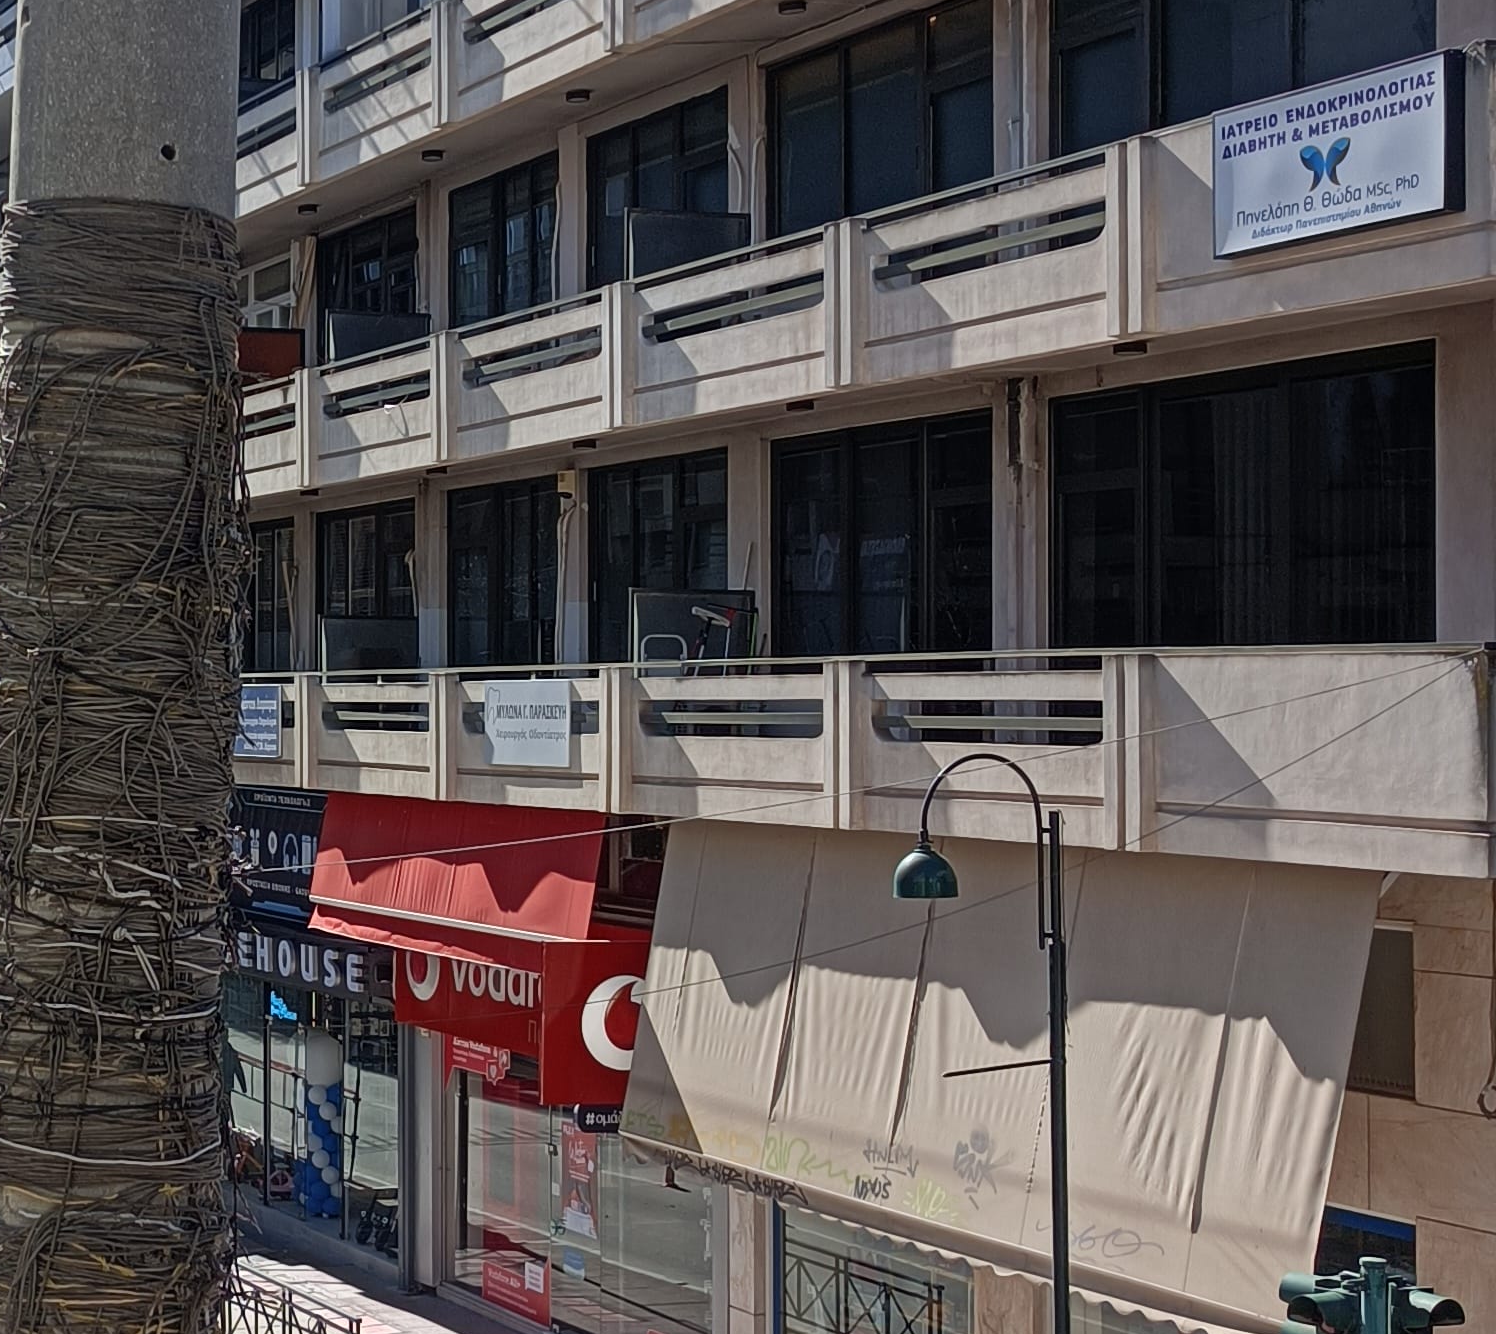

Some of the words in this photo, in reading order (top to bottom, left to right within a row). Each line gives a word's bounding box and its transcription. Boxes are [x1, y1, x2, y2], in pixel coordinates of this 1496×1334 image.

[1221, 113, 1278, 141] ΙΑΤΡΕΙΟ
[1286, 71, 1436, 124] ΕΝΔΟΚΡΙΝΟΛΟΓΙΑΣ
[1222, 131, 1286, 160] ΔΙΑΒΗΤΗ
[1292, 127, 1303, 142] &
[1309, 92, 1436, 138] ΜΕΤΑΒΟΛΙΣΜΟΥ
[1236, 200, 1300, 228] Πηνελόπη
[1304, 195, 1317, 212] Θ.
[1322, 186, 1362, 208] Θώδα
[1366, 181, 1392, 198] MSc,
[1395, 174, 1420, 193] PhD
[1252, 220, 1293, 240] Διδάκτωρ
[1296, 207, 1362, 231] Πανεπιστημίου
[1364, 198, 1402, 216] Αθηνών
[496, 704, 522, 720] ΜΥΛΩΝΑ
[530, 704, 567, 720] ΠΑΡΑΣΚΕΥΗ
